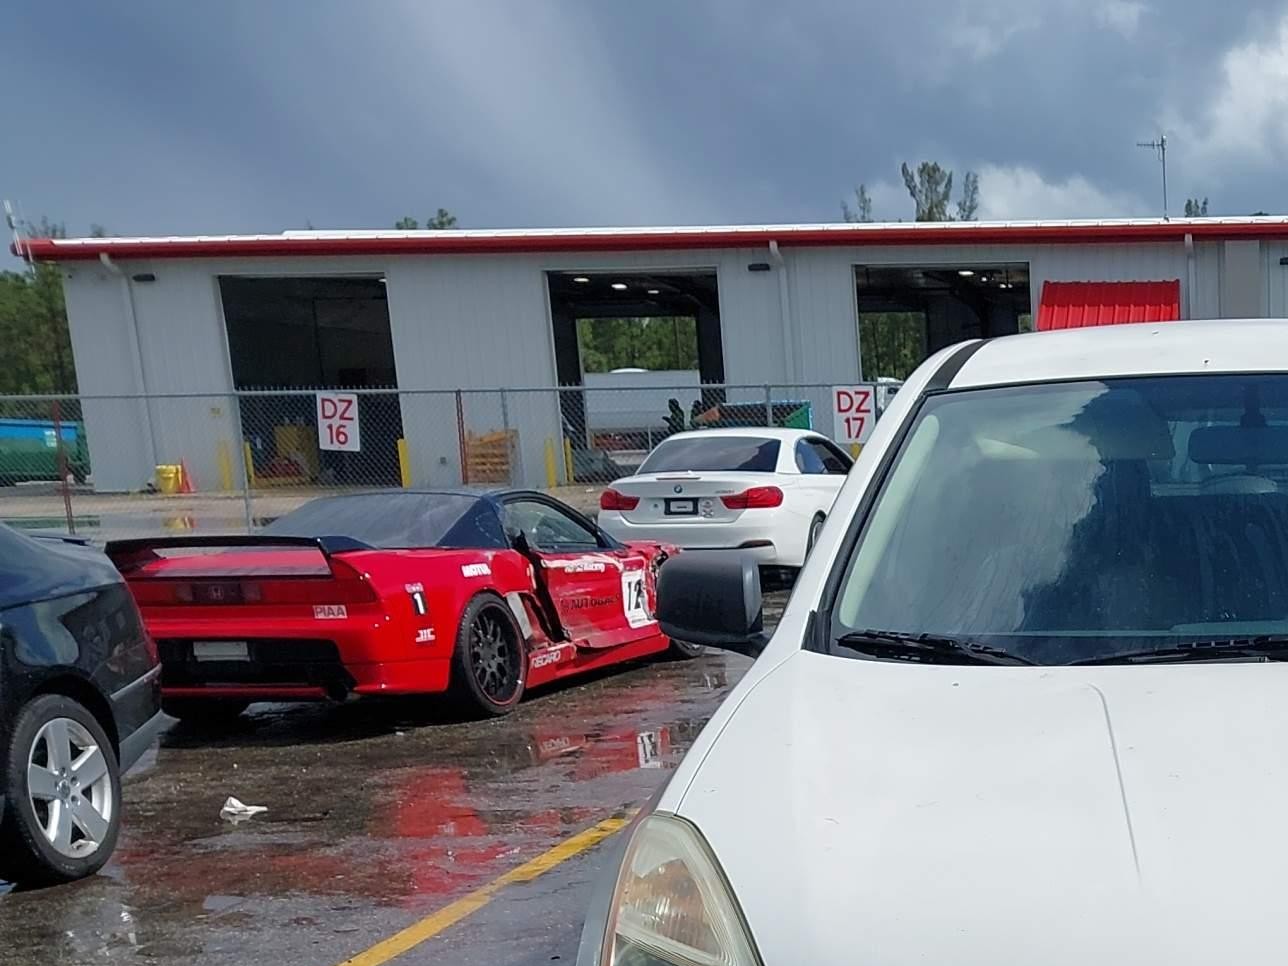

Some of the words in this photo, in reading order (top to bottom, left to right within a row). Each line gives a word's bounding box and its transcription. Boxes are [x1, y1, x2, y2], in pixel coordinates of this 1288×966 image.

[320, 397, 354, 421] DZ
[837, 391, 871, 413] DZ
[327, 424, 348, 445] 16
[844, 416, 865, 439] 17
[314, 606, 346, 617] PIAA
